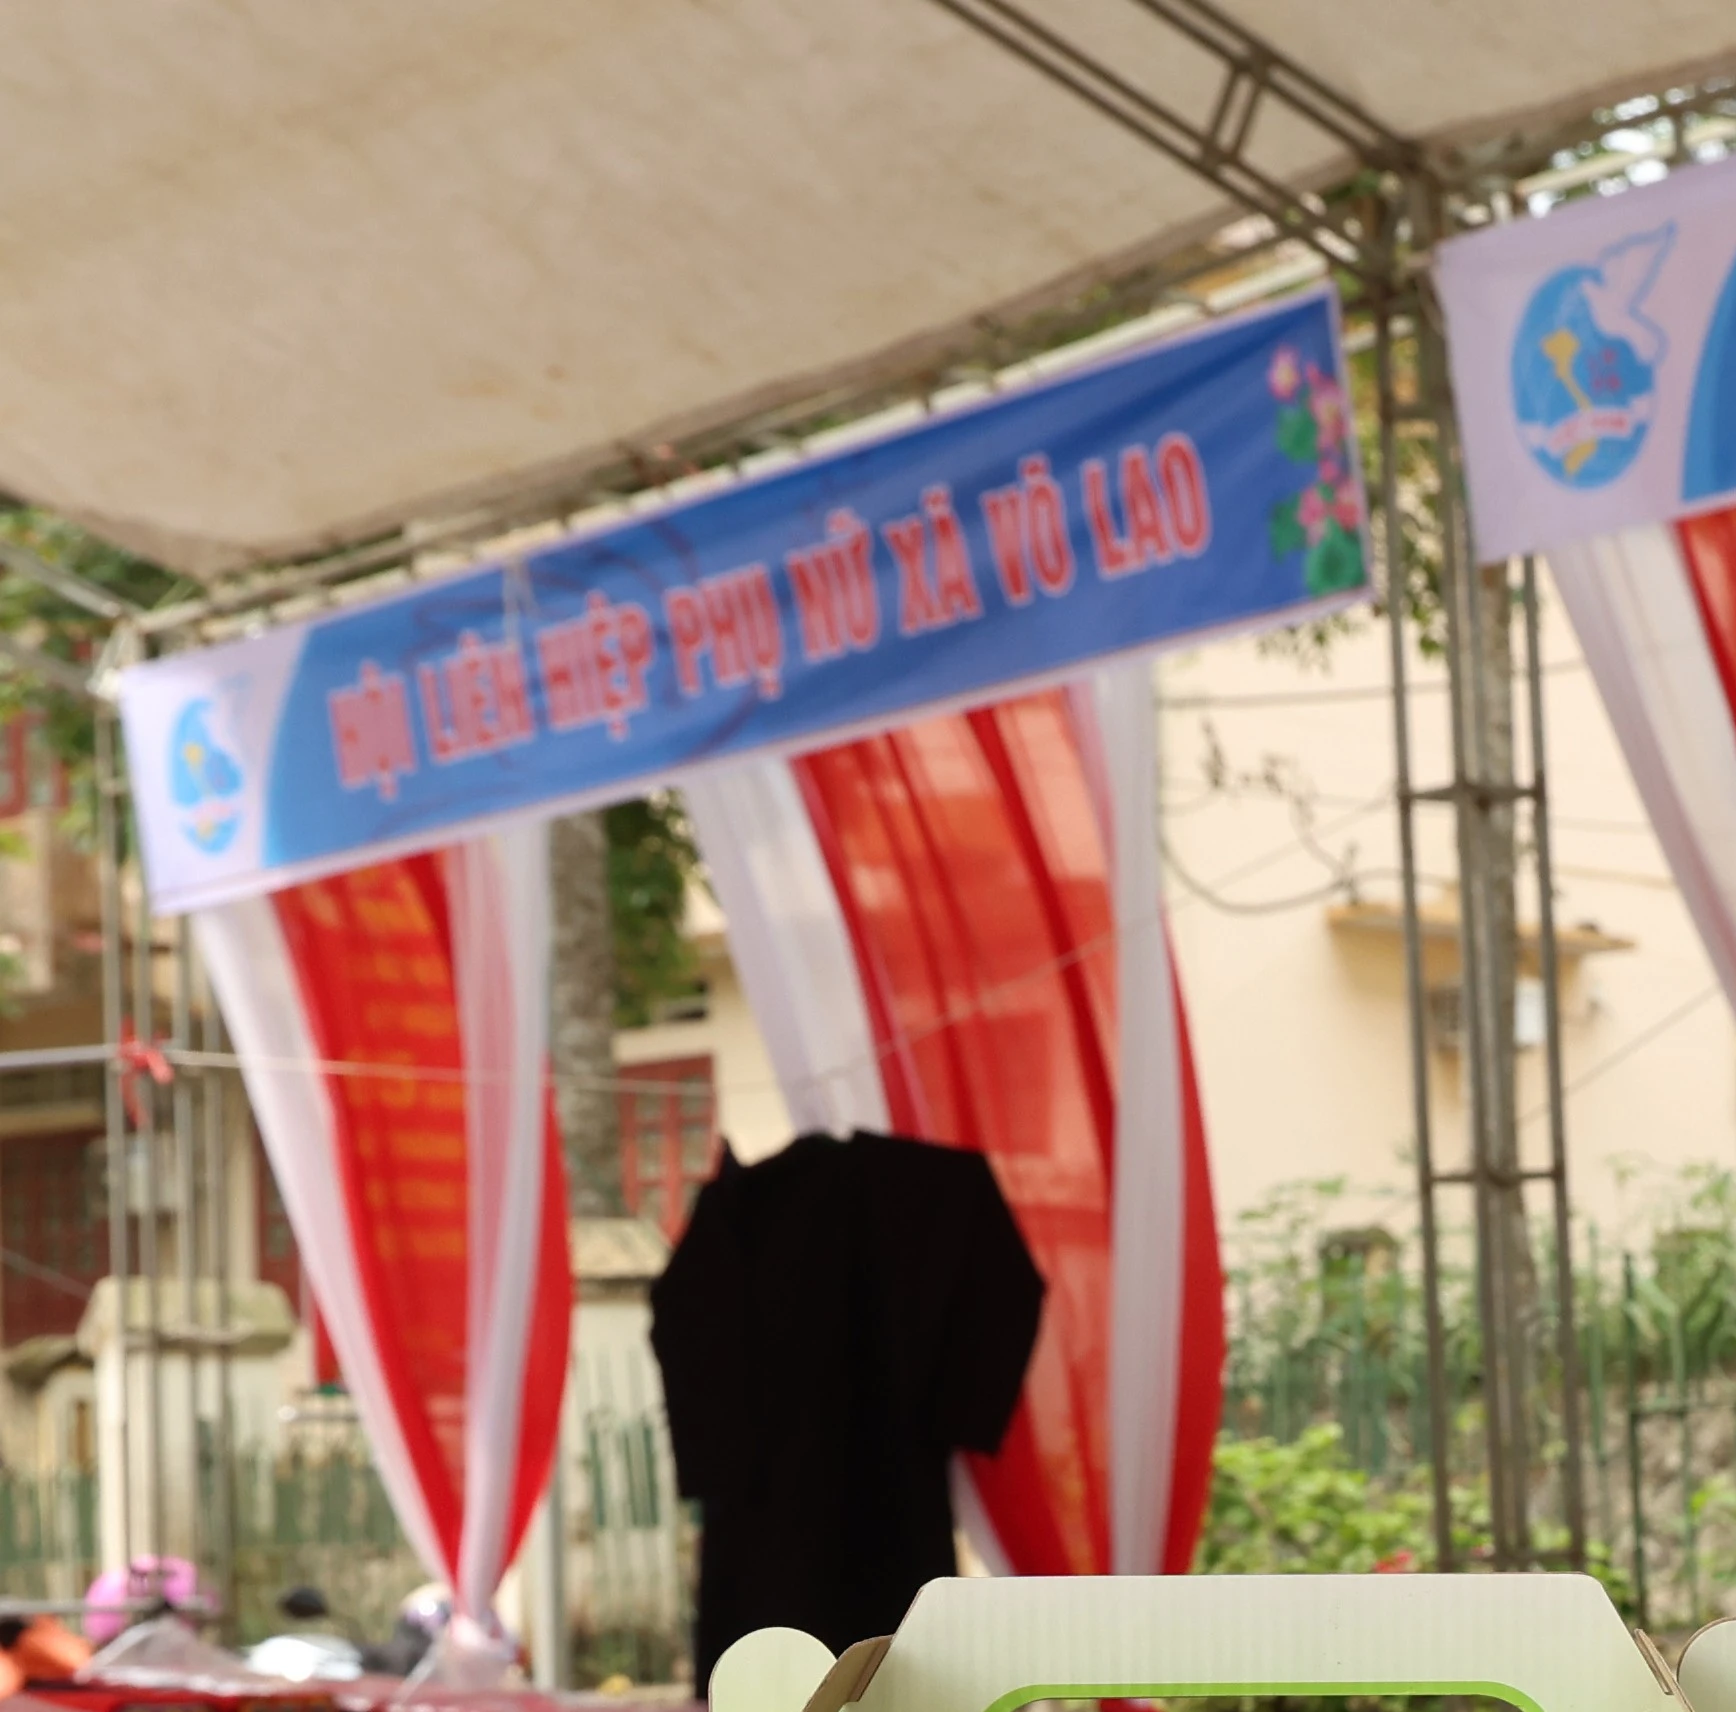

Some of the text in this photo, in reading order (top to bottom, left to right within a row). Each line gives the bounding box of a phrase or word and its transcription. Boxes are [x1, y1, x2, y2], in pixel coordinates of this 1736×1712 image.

[331, 432, 1212, 799] HỘI LIÊN HIỆP PHỤ NỮ XÃ VÕ LAO
